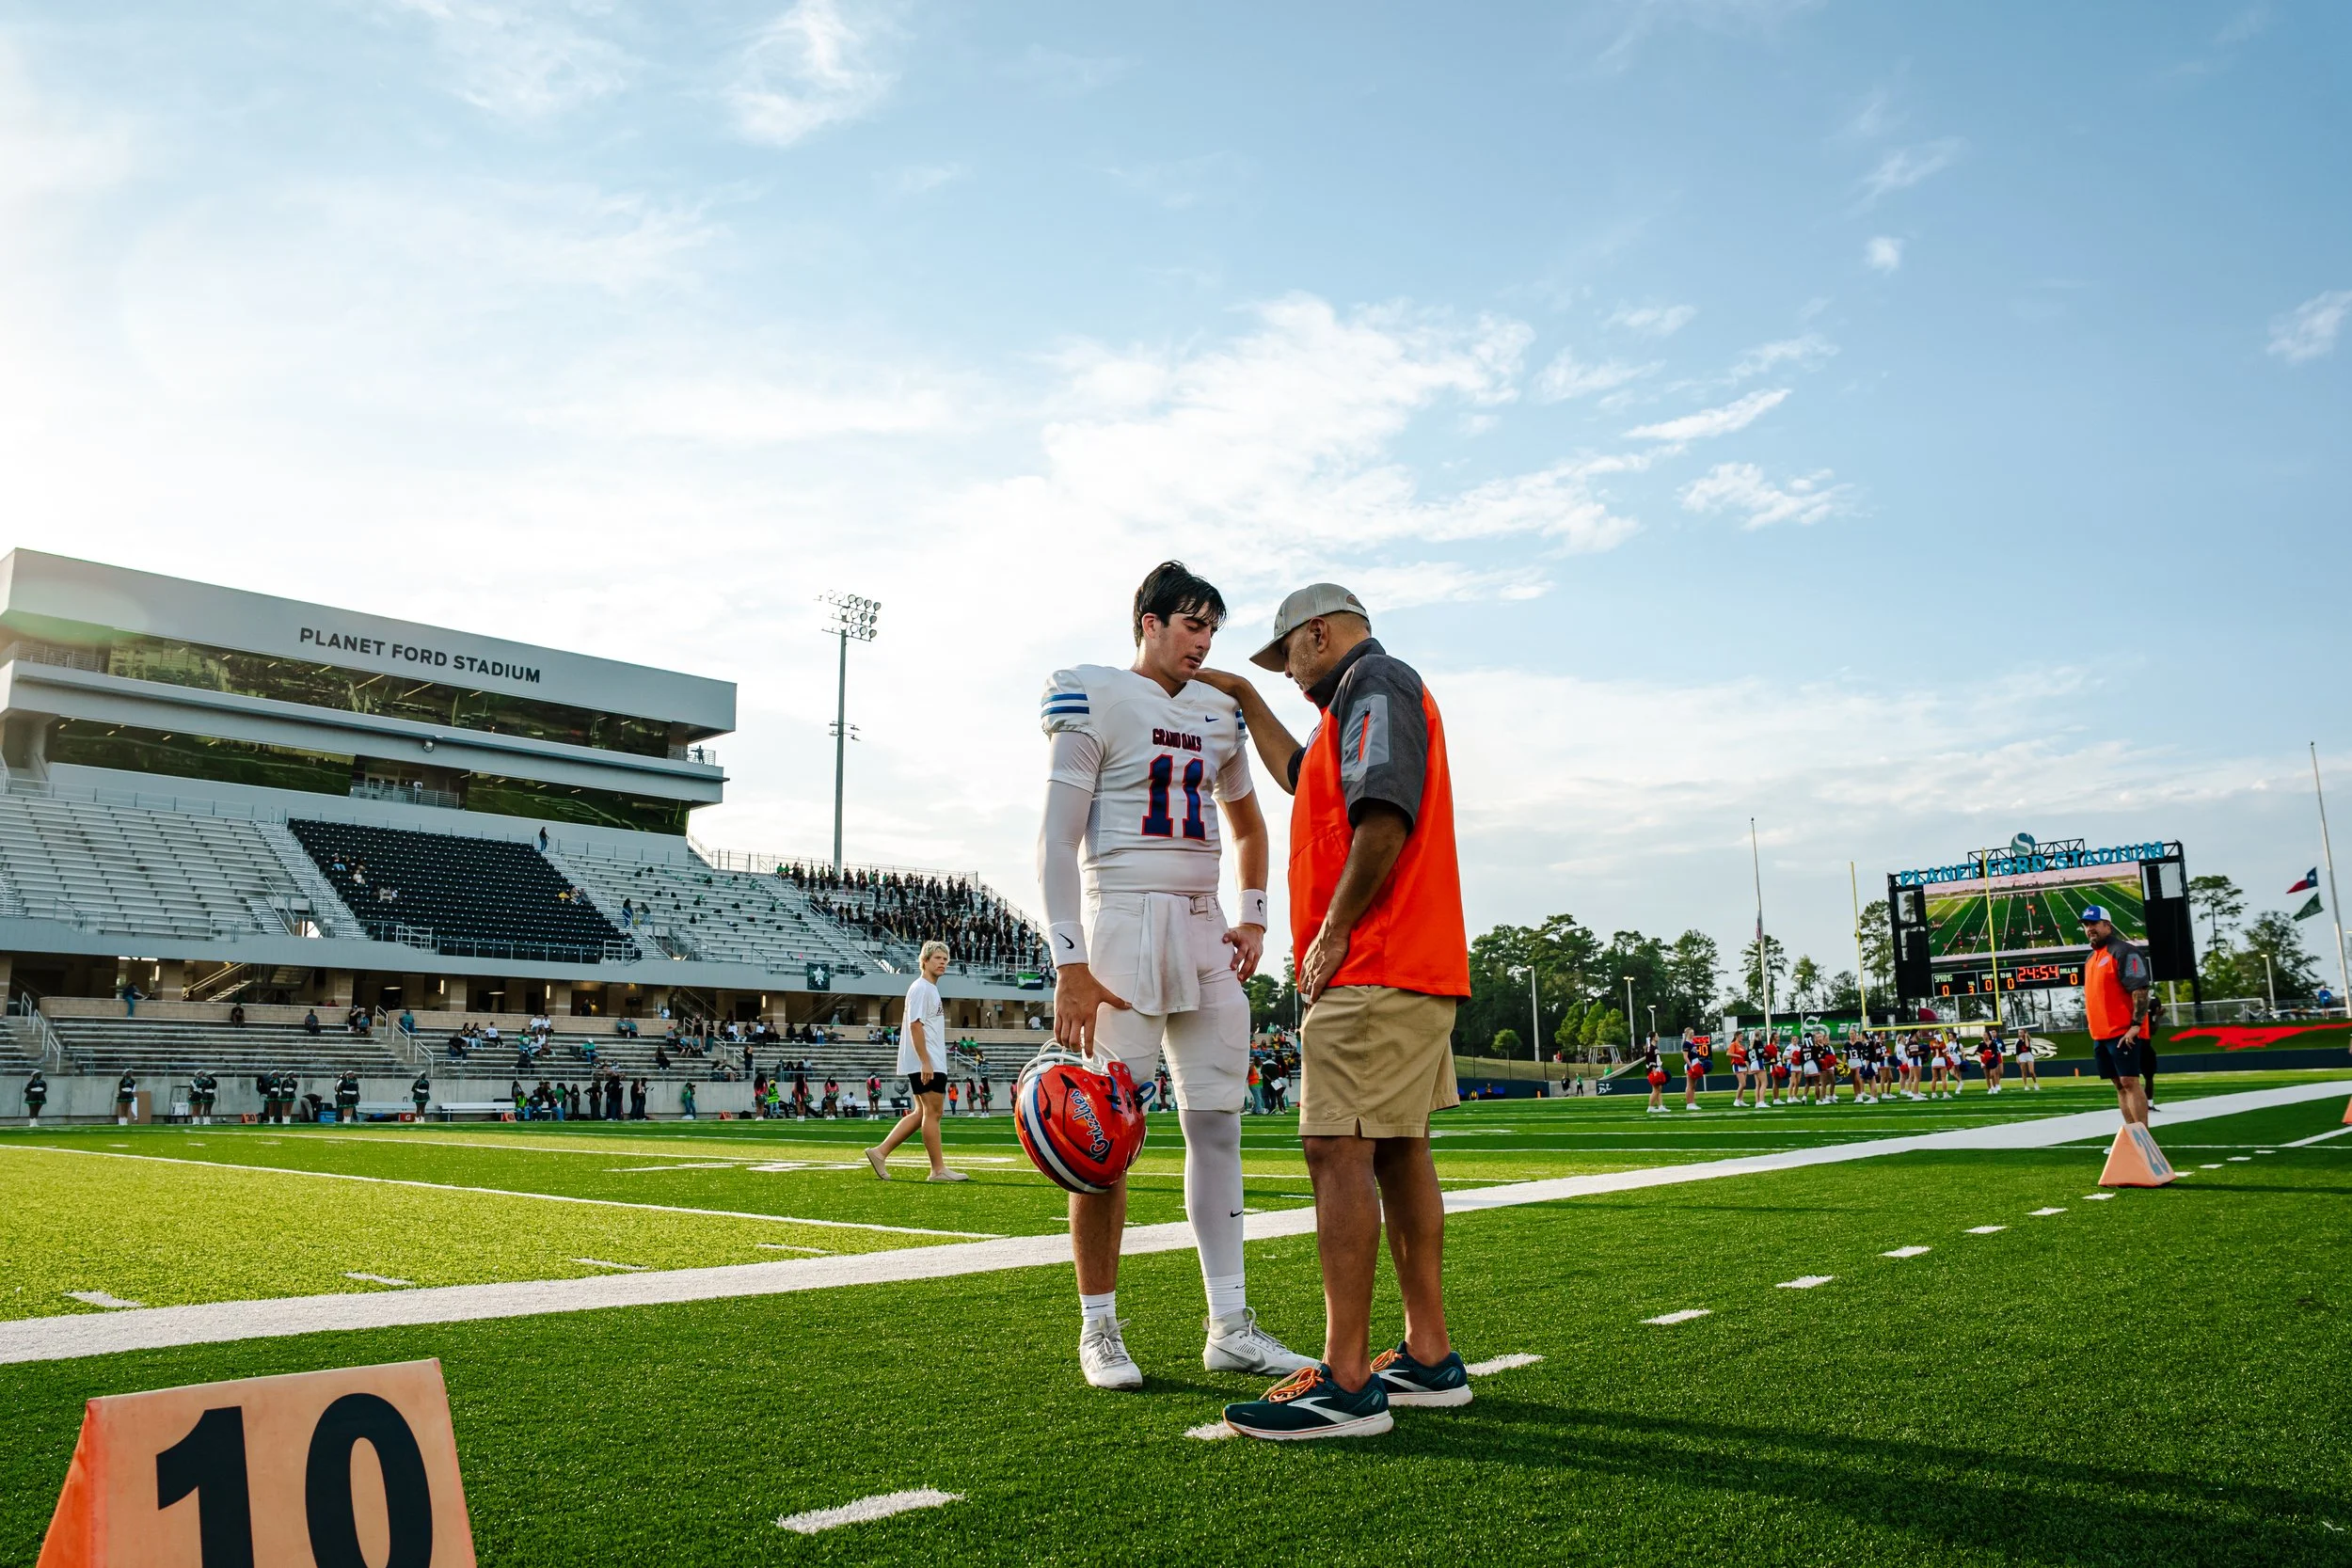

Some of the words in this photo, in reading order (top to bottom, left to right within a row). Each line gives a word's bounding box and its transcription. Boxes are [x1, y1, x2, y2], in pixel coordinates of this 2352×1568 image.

[300, 627, 386, 656] PLANET
[391, 643, 448, 666] FORD
[453, 655, 541, 683] STADIUM
[1152, 728, 1181, 749] GRAND
[1182, 733, 1202, 752] OAKS
[1141, 753, 1206, 841] 11
[1899, 862, 1981, 887] PLANET
[1987, 854, 2047, 878] FORD
[2055, 840, 2165, 870] STADIUM
[1942, 985, 1949, 996] 0
[1985, 979, 1993, 991] 0
[2007, 978, 2015, 990] 0
[2017, 965, 2058, 981] 24:54
[2070, 973, 2078, 985] 0
[1070, 1088, 1110, 1157] Grizzlies
[2132, 1128, 2169, 1177] 20
[155, 1392, 434, 1568] 10
